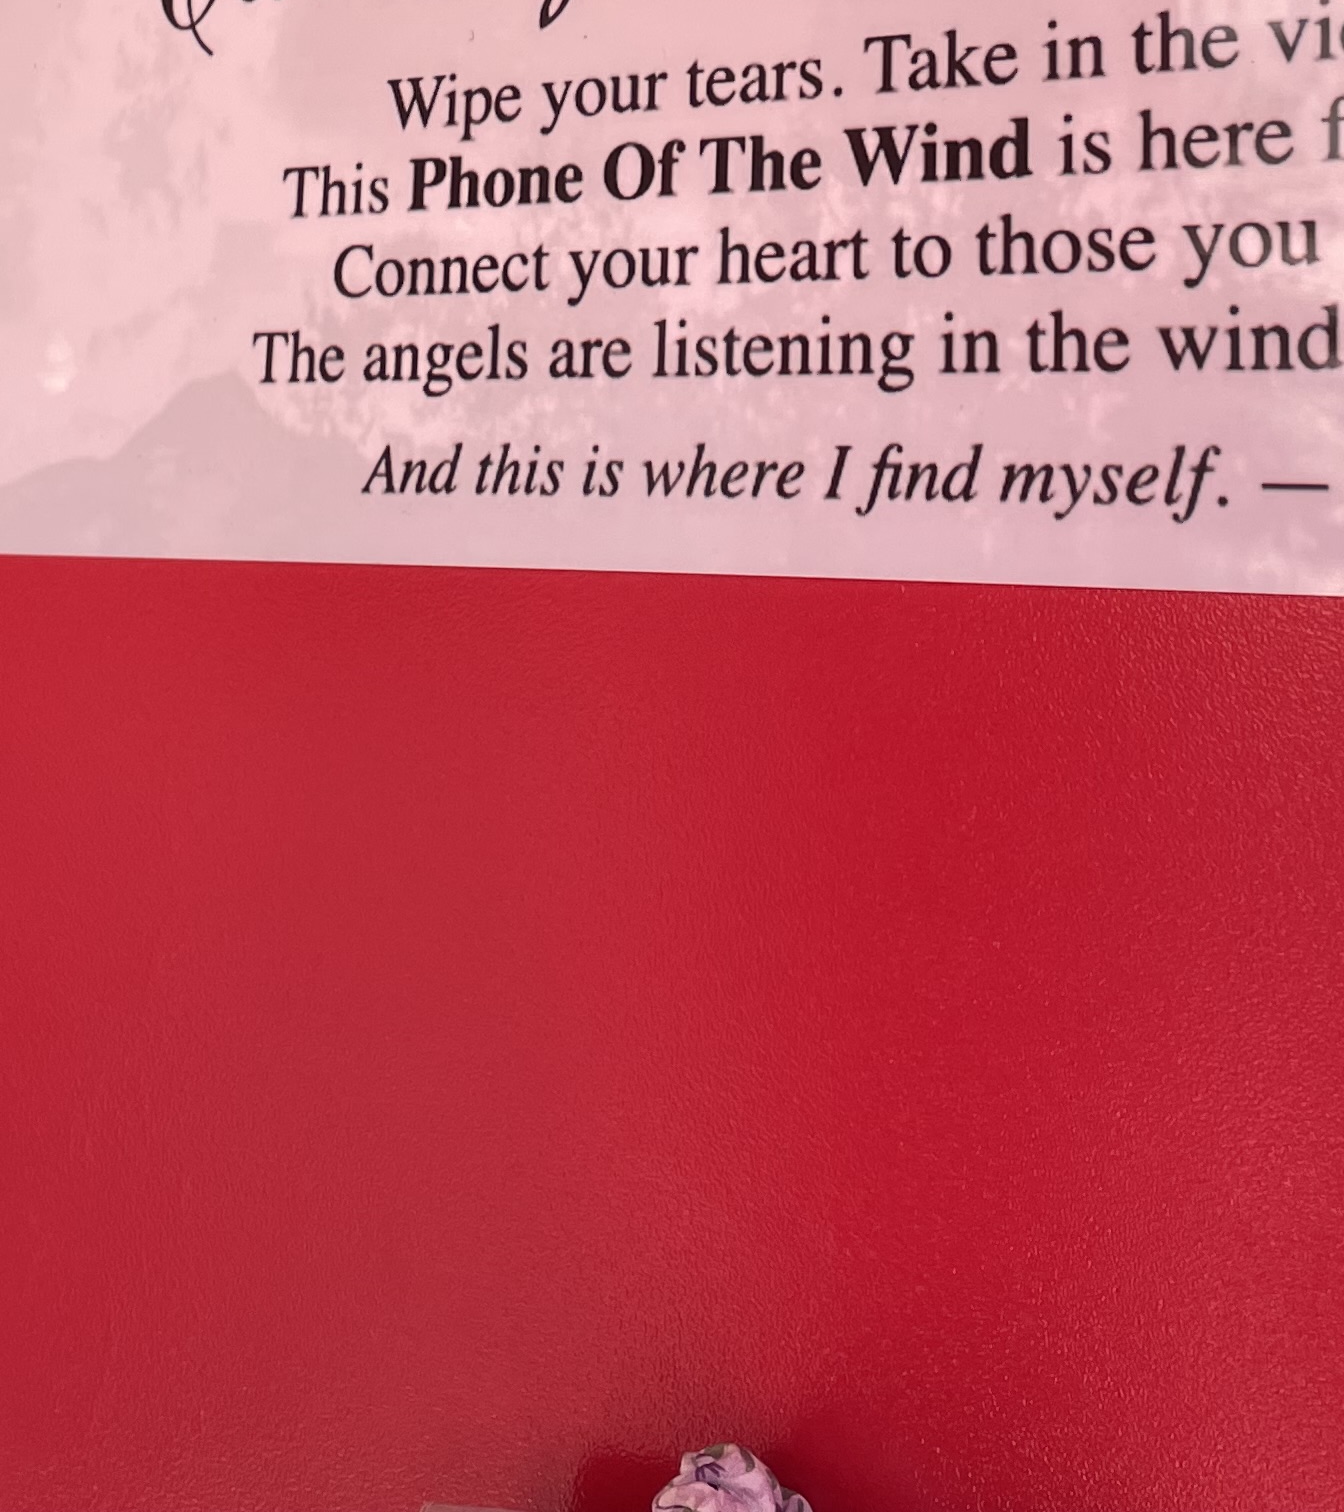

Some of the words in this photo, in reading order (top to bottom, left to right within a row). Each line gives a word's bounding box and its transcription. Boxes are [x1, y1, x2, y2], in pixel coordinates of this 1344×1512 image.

[386, 72, 523, 143] Wipe
[539, 71, 669, 137] your
[685, 58, 844, 109] tears.
[862, 28, 1019, 94] Take
[1044, 19, 1107, 82] in
[1130, 9, 1239, 76] the
[281, 161, 390, 219] This
[408, 155, 584, 212] Phone
[603, 139, 688, 201] Of
[697, 133, 824, 196] The
[842, 115, 1034, 188] Wind
[1058, 113, 1113, 176] is
[1138, 108, 1295, 172] here
[332, 243, 551, 300] Connect
[566, 245, 700, 308] your
[716, 225, 870, 285] heart
[890, 226, 953, 280] to
[974, 212, 1157, 277] those
[1181, 219, 1320, 290] you
[251, 329, 346, 385] The
[362, 322, 529, 399] angels
[548, 337, 633, 380] are
[652, 314, 916, 395] listening
[940, 310, 1002, 375] in
[1025, 308, 1131, 374] the
[360, 441, 464, 496] And
[474, 441, 565, 497] this
[581, 443, 625, 498] is
[642, 442, 806, 501] where
[824, 444, 853, 501] I
[854, 442, 984, 518] find
[998, 444, 1230, 525] myself.
